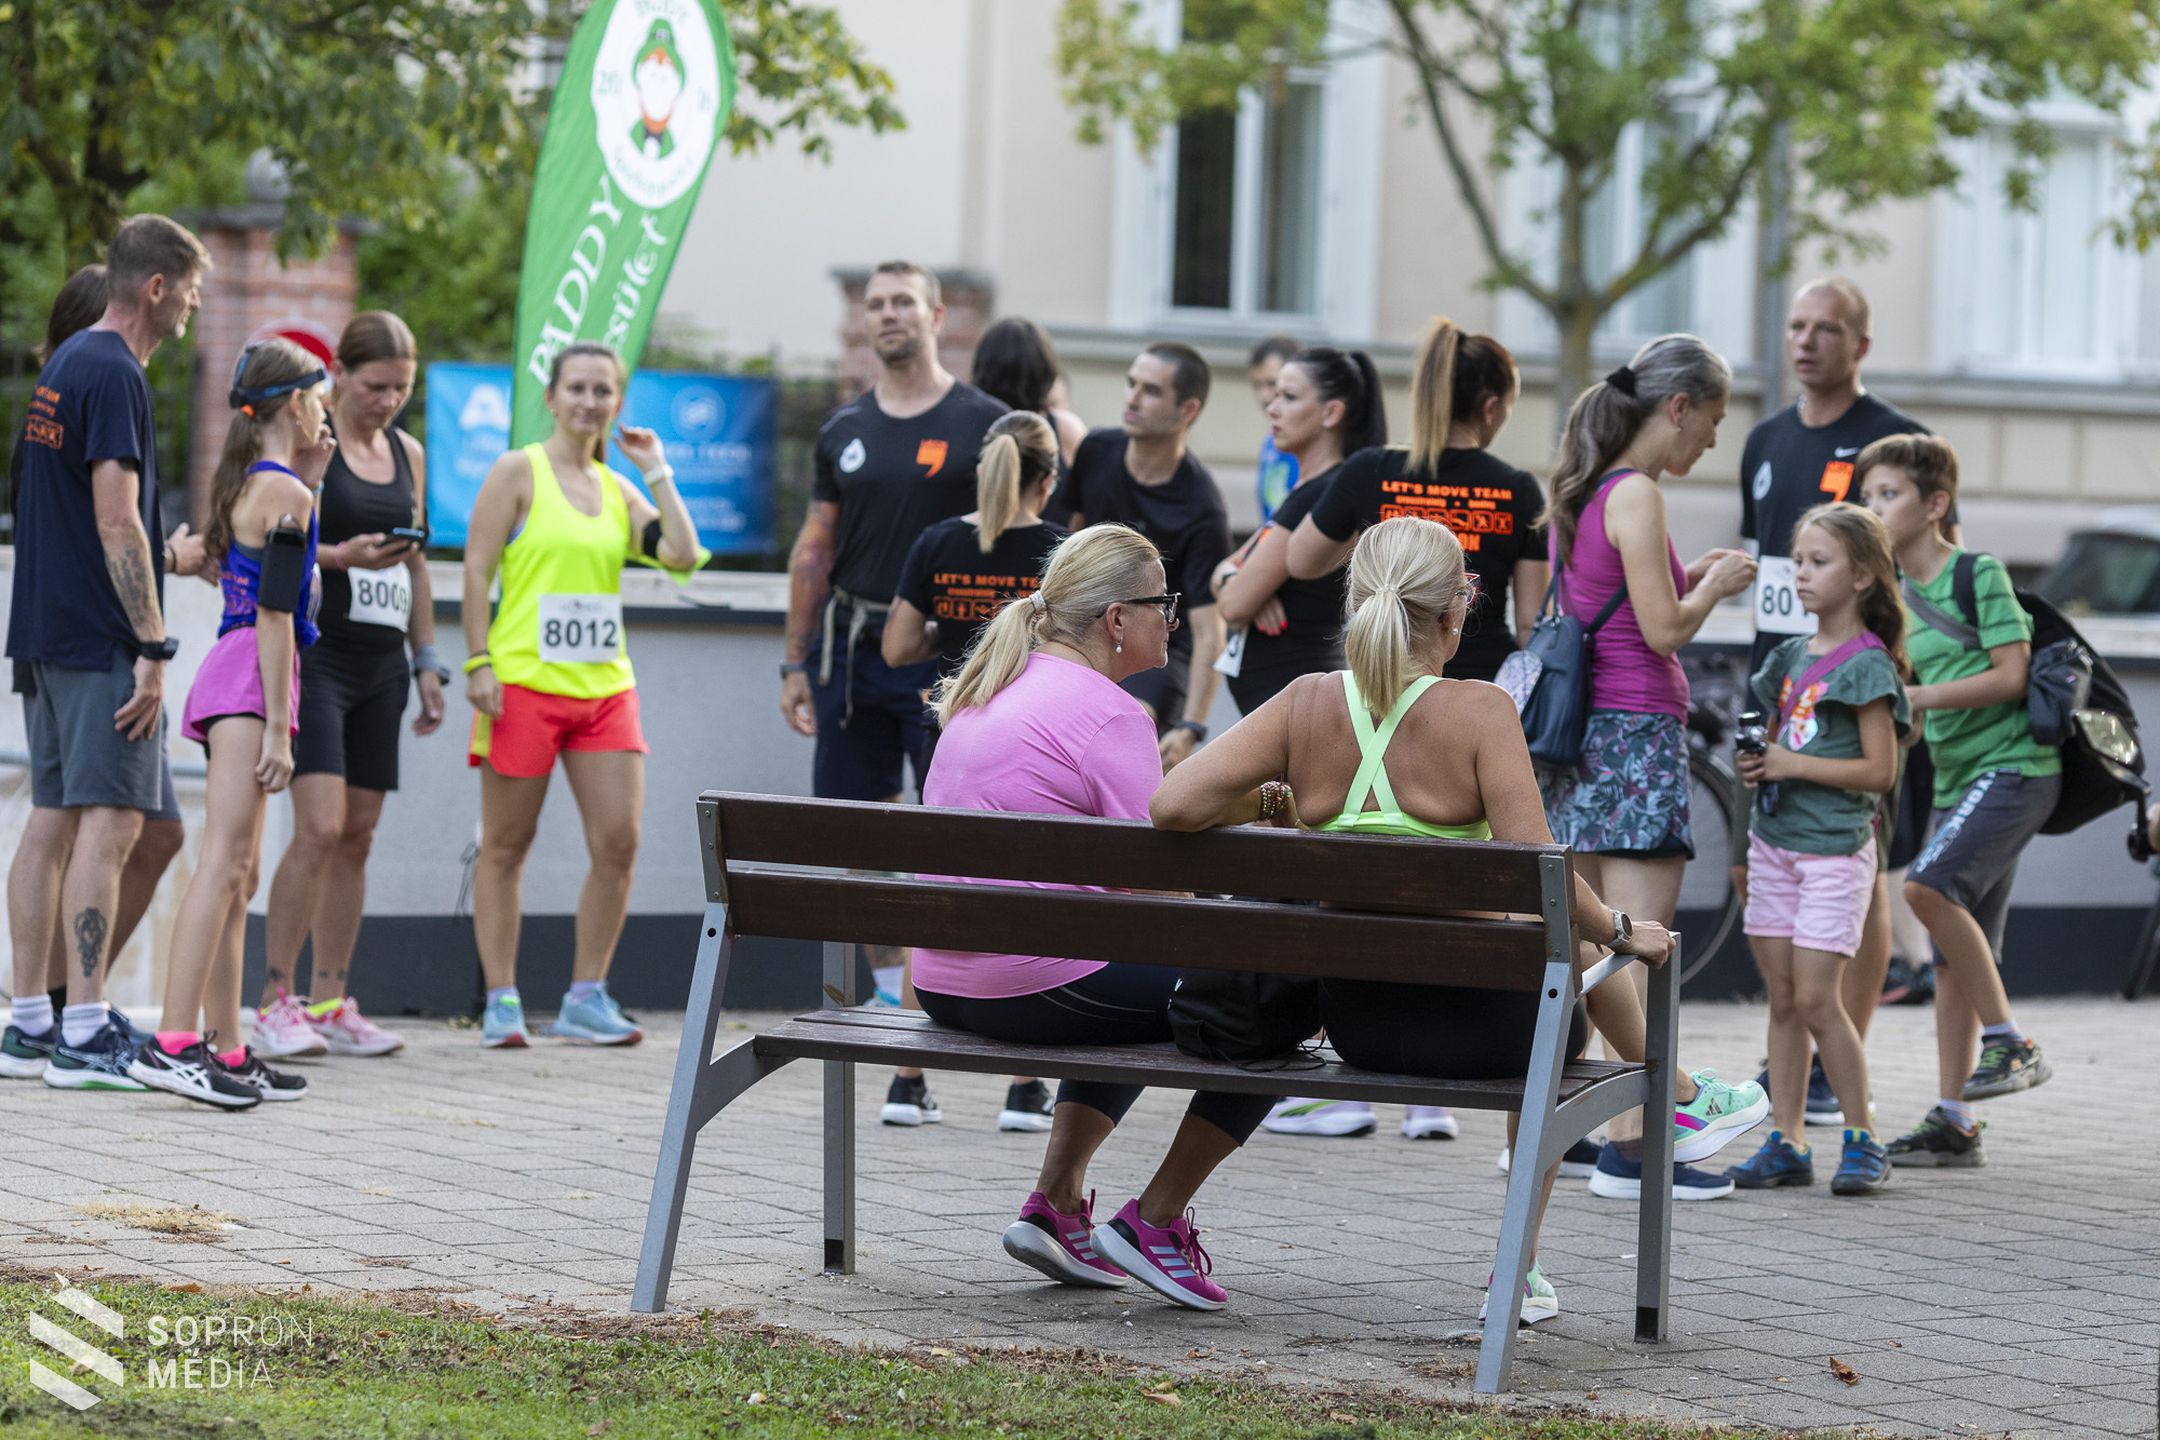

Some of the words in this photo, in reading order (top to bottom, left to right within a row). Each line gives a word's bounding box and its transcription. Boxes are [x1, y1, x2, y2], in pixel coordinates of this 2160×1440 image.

[528, 174, 623, 386] PADDY
[1381, 480, 1423, 495] LET'S
[1426, 484, 1470, 498] MOVE
[1472, 487, 1513, 500] TEAM
[933, 573, 971, 585] LET'S
[975, 575, 1016, 587] MOVE
[1019, 577, 1041, 588] TE
[1761, 585, 1808, 616] 80
[545, 619, 616, 648] 8012
